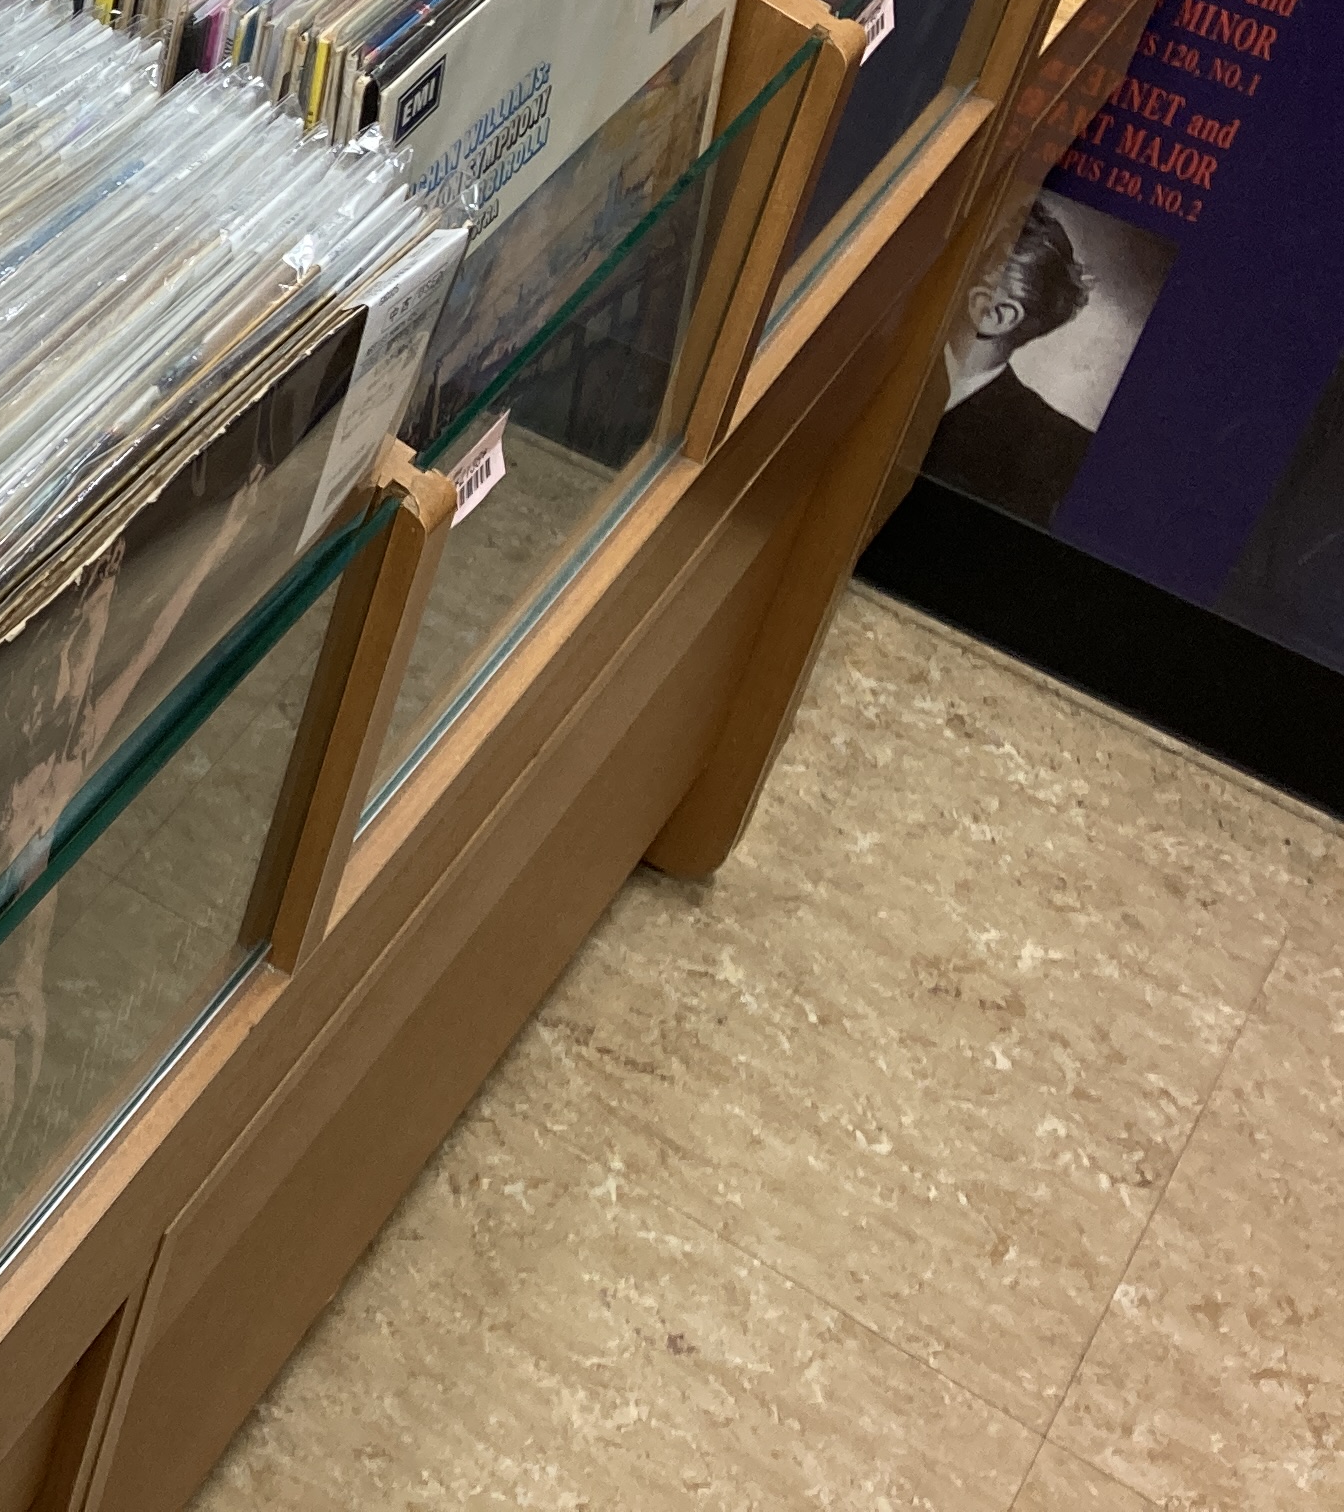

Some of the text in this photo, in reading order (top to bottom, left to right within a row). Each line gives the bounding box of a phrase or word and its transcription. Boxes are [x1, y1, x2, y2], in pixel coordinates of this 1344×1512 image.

[401, 78, 437, 128] EMI
[1115, 122, 1220, 190] MAJOR
[1186, 113, 1241, 151] and
